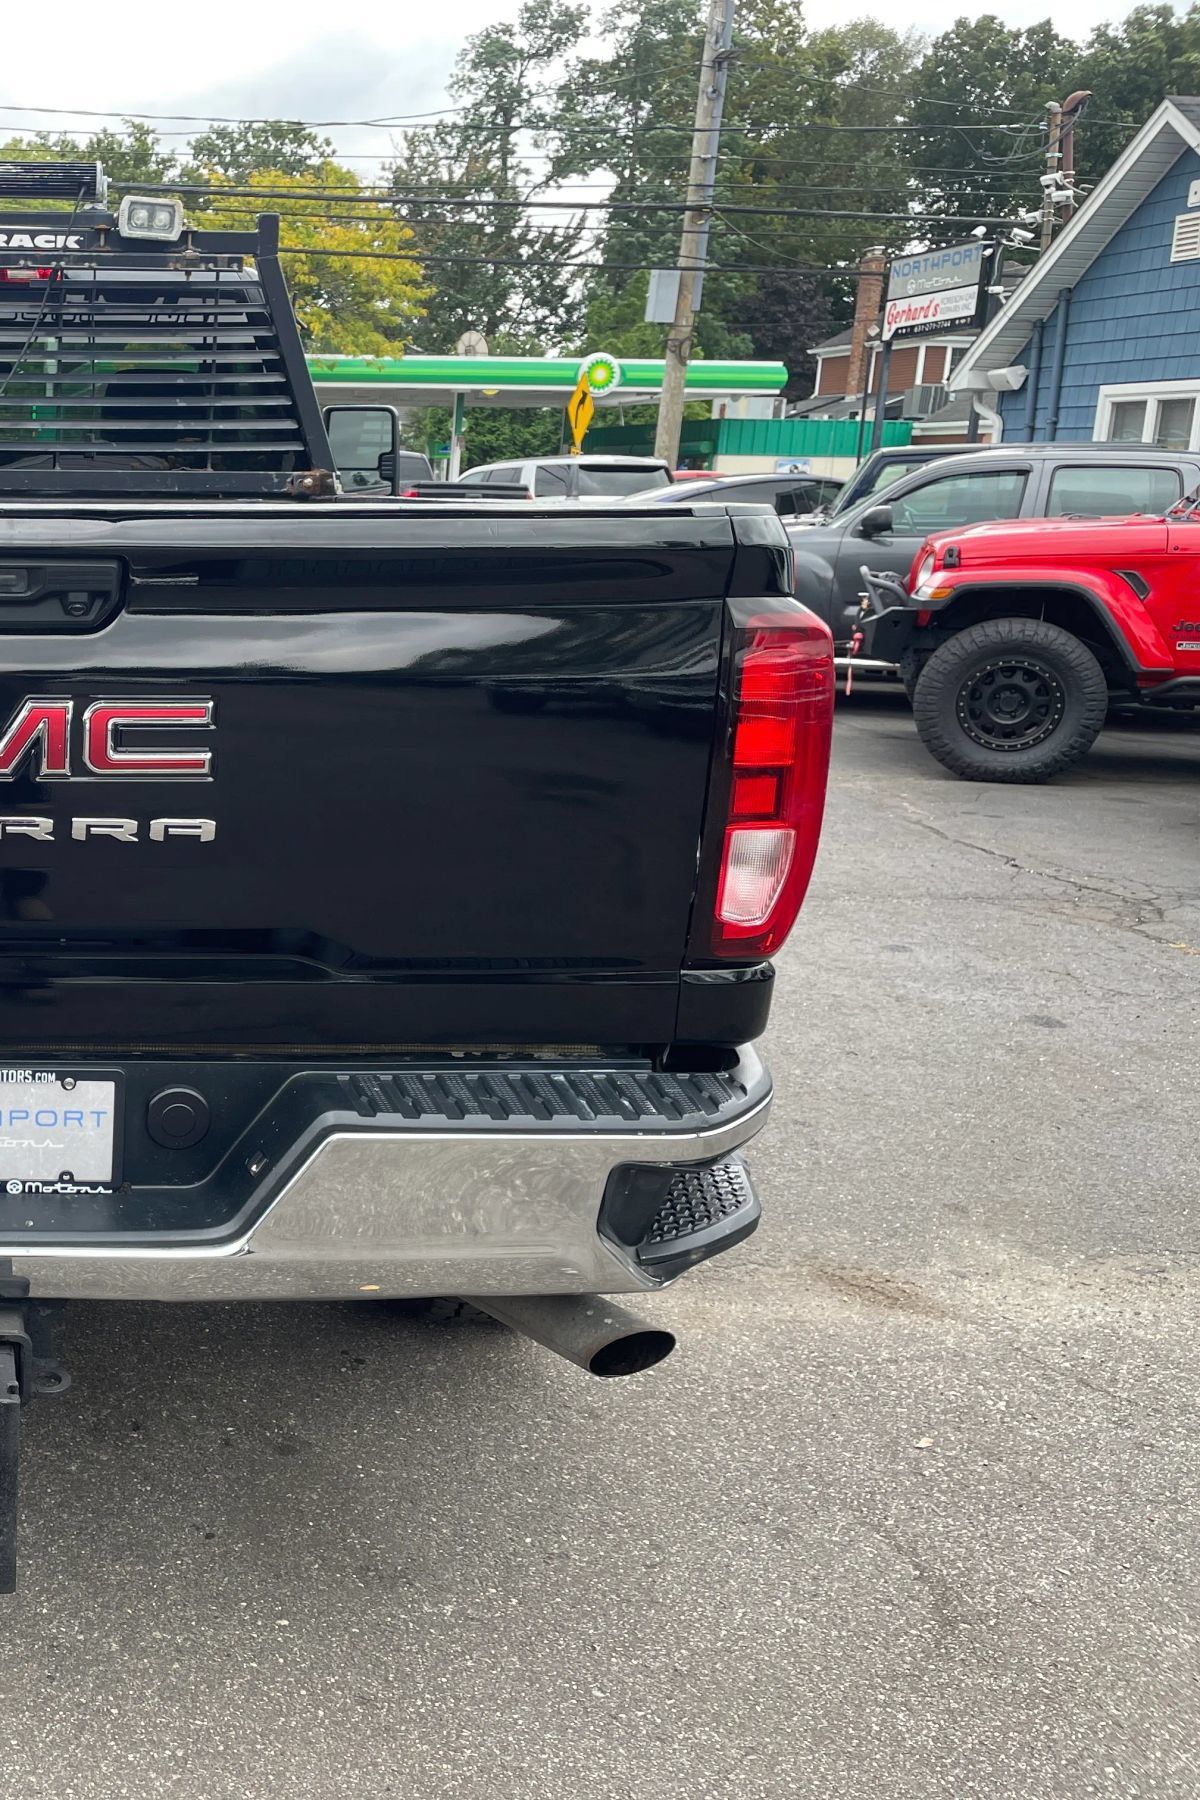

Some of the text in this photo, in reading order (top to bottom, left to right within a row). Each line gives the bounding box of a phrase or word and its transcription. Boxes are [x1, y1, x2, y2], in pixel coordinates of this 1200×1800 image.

[892, 243, 984, 279] NORTHPORT
[887, 297, 940, 333] Gerhard's
[24, 1180, 112, 1194] Motors
